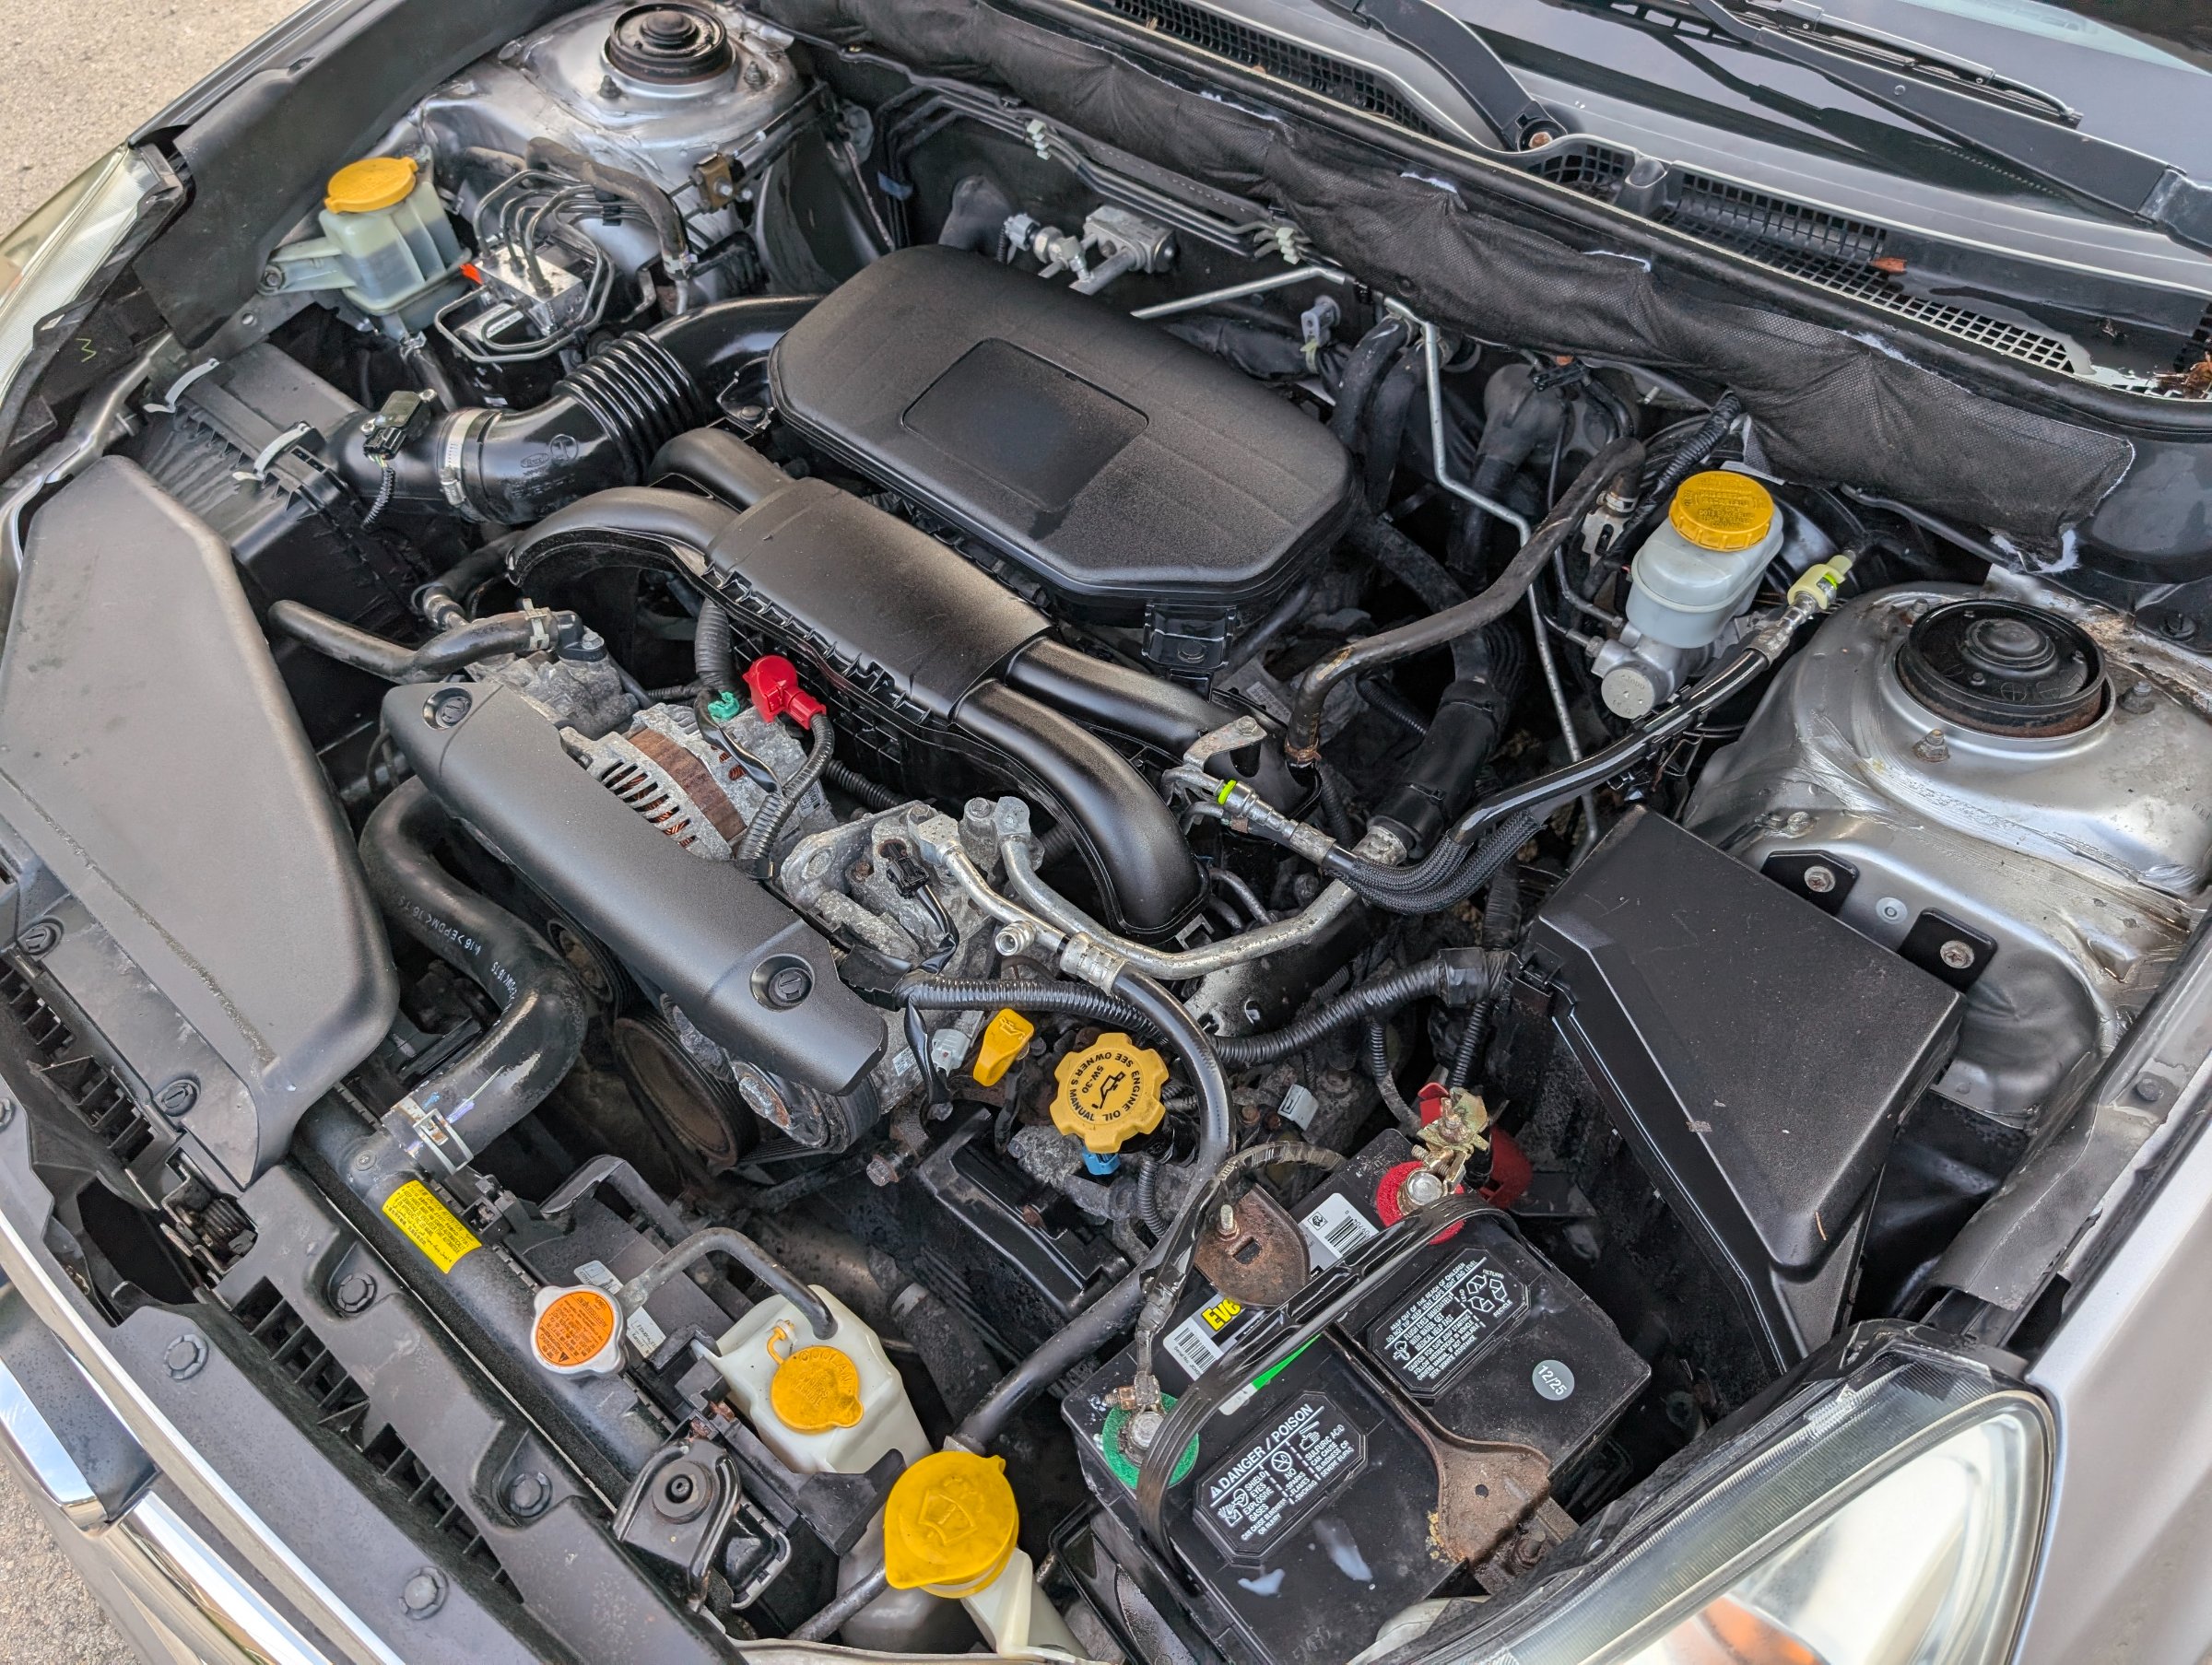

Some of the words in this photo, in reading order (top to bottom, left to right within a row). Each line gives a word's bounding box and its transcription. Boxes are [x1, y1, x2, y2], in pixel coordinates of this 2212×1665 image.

[1070, 1051, 1112, 1085] OWNER'S
[1114, 1052, 1133, 1067] SEE
[1081, 1064, 1103, 1093] 5W-30
[1122, 1070, 1140, 1111] ENGINE
[1069, 1088, 1094, 1120] MANUAL
[1102, 1110, 1120, 1120] OIL
[1390, 1319, 1401, 1331] KEEP
[1401, 1310, 1410, 1320] OUT
[1417, 1296, 1426, 1306] THE
[1425, 1284, 1440, 1298] REACH
[1438, 1278, 1445, 1286] OF
[1444, 1262, 1465, 1280] CHILDREN
[1393, 1326, 1403, 1336] NOT
[1410, 1308, 1421, 1320] KEEP
[1421, 1298, 1432, 1310] VENT
[1431, 1289, 1444, 1300] CAPS
[1442, 1277, 1455, 1290] TIGHT
[1455, 1270, 1465, 1280] AND
[1464, 1260, 1477, 1272] LEVEL
[1493, 1299, 1512, 1317] RECYCLE
[1403, 1325, 1418, 1340] FLUSH
[1416, 1316, 1429, 1329] EYES
[1427, 1294, 1453, 1319] IMMEDIATELY
[1409, 1333, 1421, 1344] WITH
[1433, 1312, 1444, 1322] GET
[1413, 1359, 1430, 1375] FOLLOW
[1457, 1319, 1474, 1333] VEHICLE
[1414, 1333, 1434, 1351] MEDICAL
[1430, 1323, 1443, 1336] HELP
[1441, 1314, 1453, 1326] FAST
[1424, 1347, 1434, 1356] FOR
[1431, 1338, 1443, 1349] SAFE
[1452, 1339, 1461, 1348] NOT
[1537, 1365, 1567, 1395] 12/25
[1218, 1446, 1265, 1488] DANGER
[1271, 1403, 1312, 1442] POISON
[1305, 1436, 1332, 1460] SULFURIC
[1330, 1424, 1345, 1438] ACID
[1311, 1455, 1322, 1465] CAN
[1321, 1441, 1337, 1456] CAUSE
[1315, 1447, 1341, 1471] BLINDNESS
[1340, 1440, 1348, 1448] OR
[1244, 1471, 1265, 1491] SHIELD
[1284, 1468, 1296, 1480] NO
[1320, 1460, 1338, 1476] SEVERE
[1242, 1486, 1274, 1515] EXPLOSIVE
[1250, 1482, 1266, 1497] EYES
[1248, 1503, 1268, 1521] GASES
[1241, 1529, 1253, 1540] CAN
[1250, 1517, 1265, 1531] CAUSE
[1257, 1526, 1266, 1534] OR
